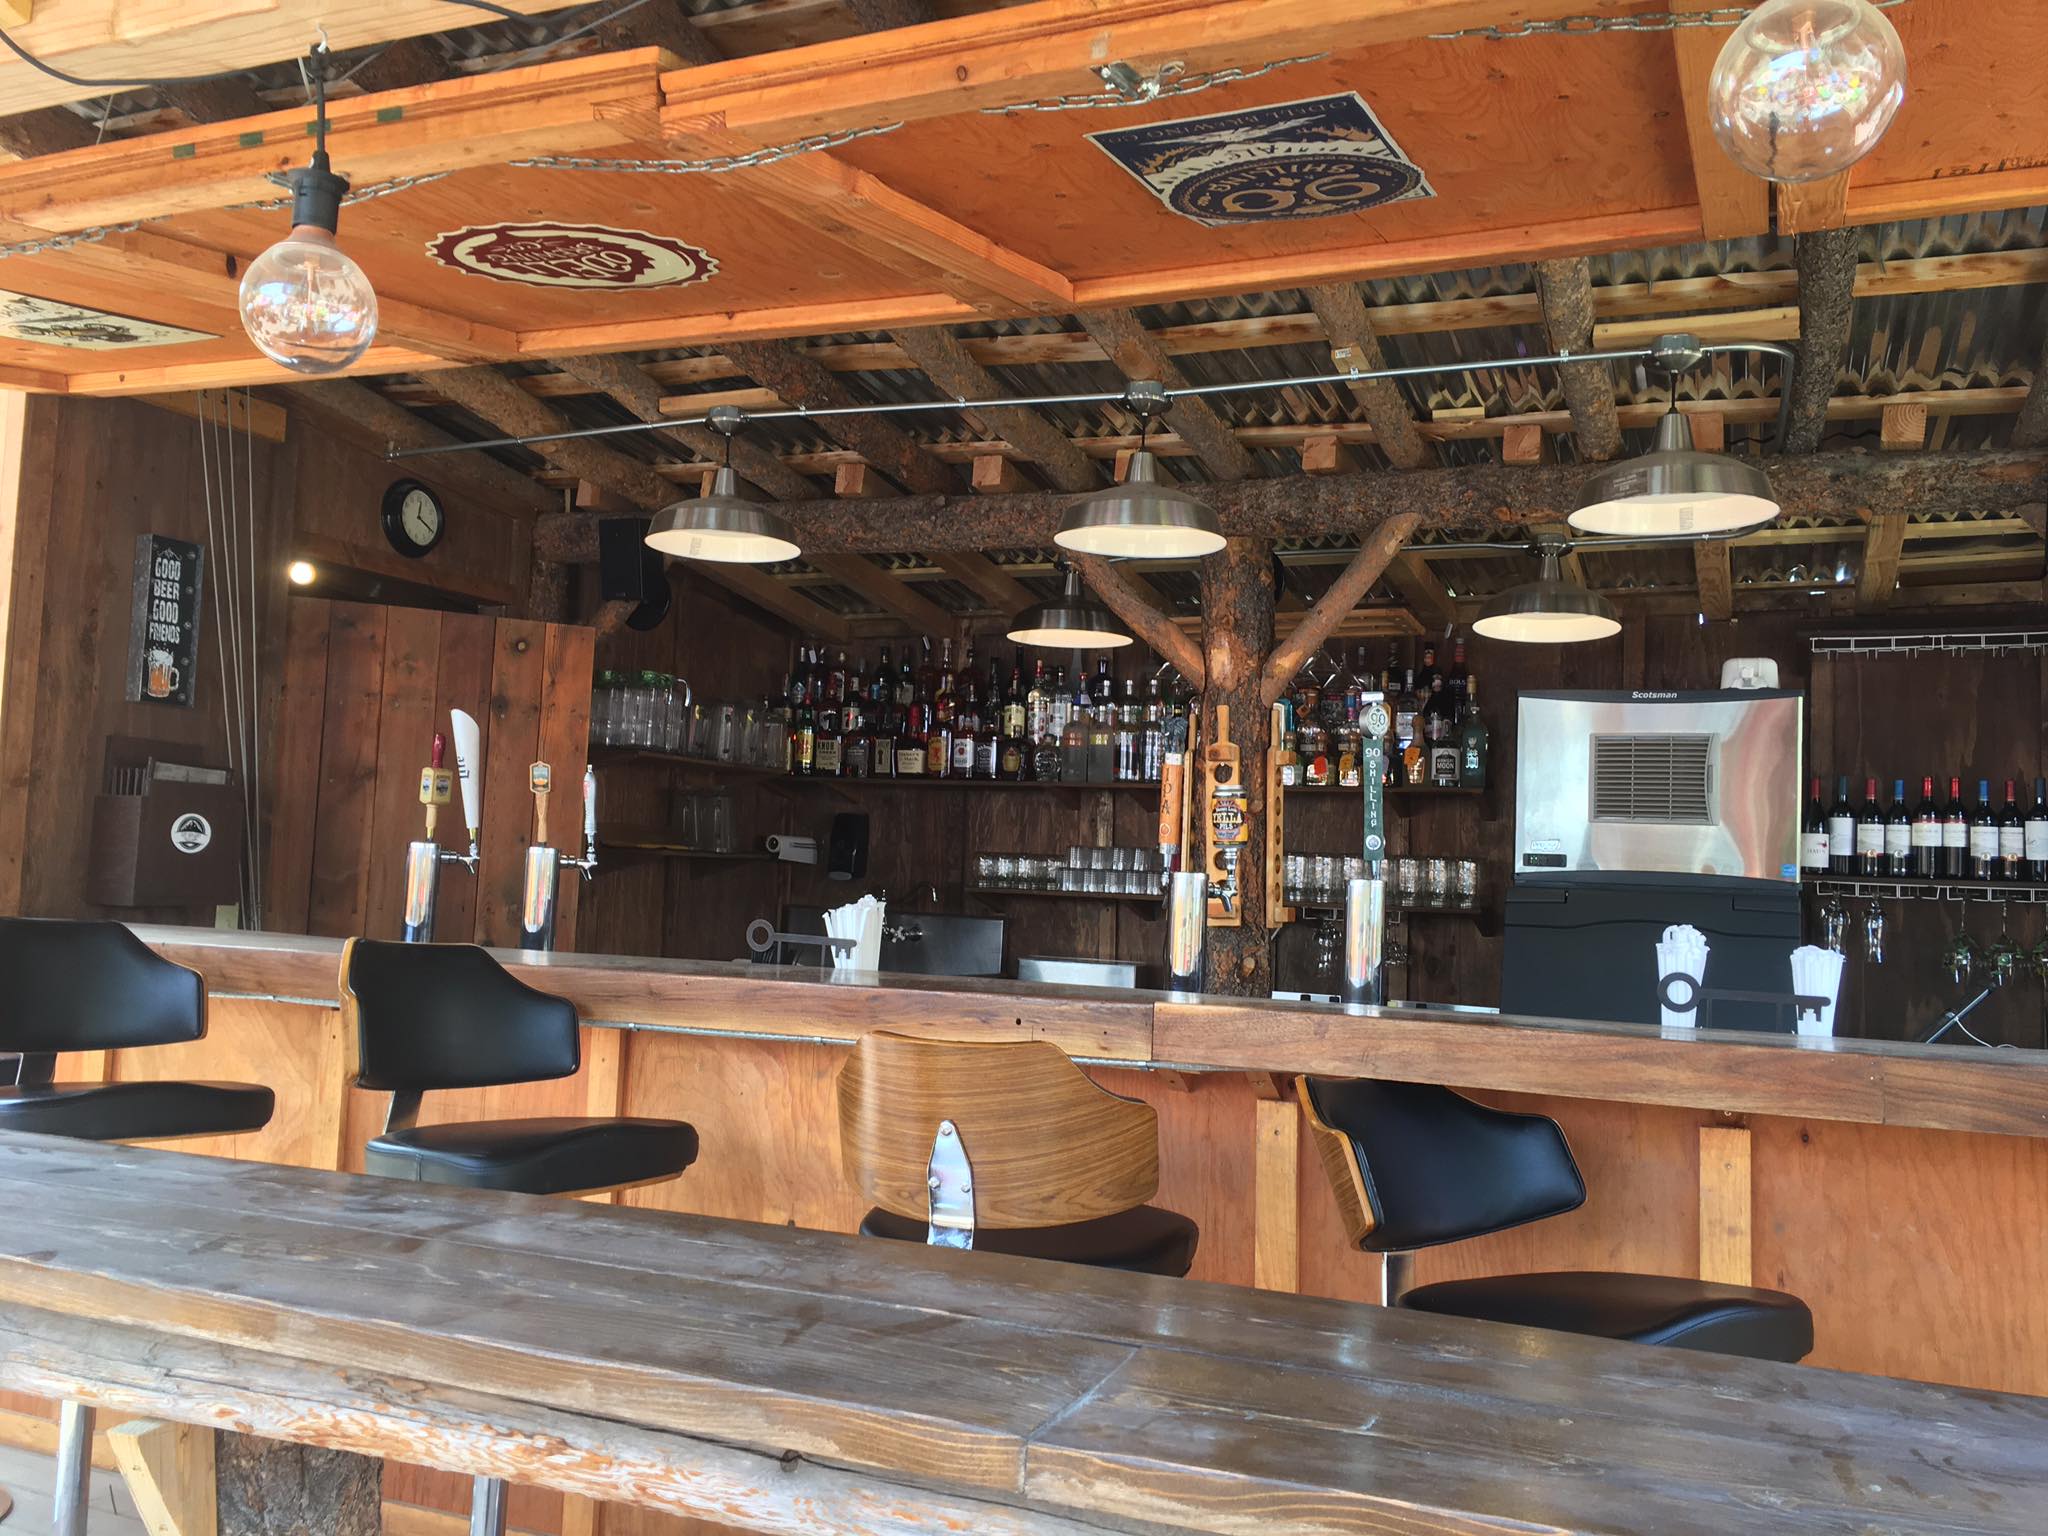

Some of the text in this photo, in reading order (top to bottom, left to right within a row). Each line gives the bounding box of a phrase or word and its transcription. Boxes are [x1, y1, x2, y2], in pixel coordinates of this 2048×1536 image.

[1265, 100, 1348, 119] ODELL
[1144, 114, 1258, 138] BREWING
[1208, 163, 1355, 192] SHILLING
[1222, 173, 1381, 213] 90
[485, 242, 604, 262] BREWING
[501, 251, 633, 278] ODELL
[155, 557, 181, 580] GOOD
[153, 579, 180, 600] BEER
[152, 599, 179, 624] GOOD
[149, 621, 181, 644] FRIENDS
[1631, 691, 1678, 699] Scotsman
[1365, 747, 1381, 758] 90
[1369, 760, 1377, 828] SHILLING
